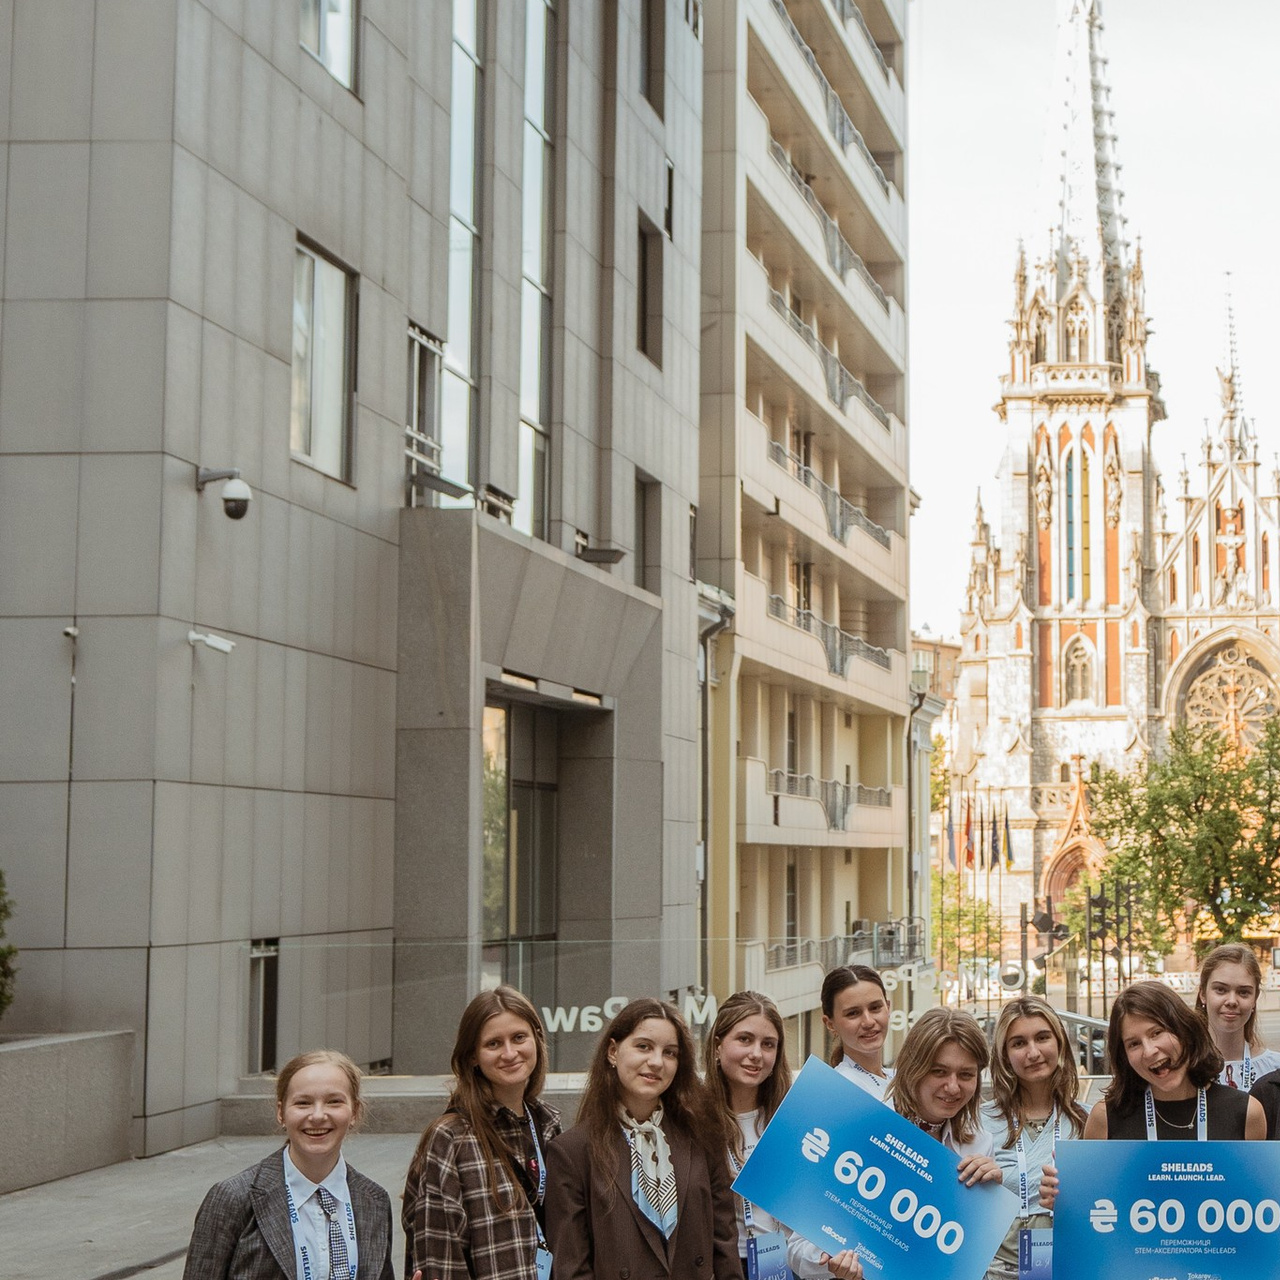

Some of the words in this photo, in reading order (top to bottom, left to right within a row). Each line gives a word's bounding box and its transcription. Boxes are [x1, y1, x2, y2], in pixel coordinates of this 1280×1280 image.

[1146, 1090, 1155, 1127] SHELEADS
[870, 1136, 890, 1154] LEARN.
[890, 1150, 917, 1171] LAUNCH.
[916, 1168, 933, 1183] LEAD.
[884, 1133, 929, 1168] SHELEADS
[1148, 1174, 1173, 1182] LEARN.
[1174, 1174, 1205, 1182] LAUNCH.
[1206, 1174, 1226, 1182] LEAD.
[1161, 1163, 1213, 1172] SHELEADS
[834, 1150, 887, 1200] 60
[889, 1188, 965, 1255] 000
[850, 1198, 893, 1231] ПЕРЕМОЖНИЦЯ
[1129, 1198, 1185, 1234] 60
[344, 1202, 356, 1241] SHELEADS
[821, 1224, 848, 1246] uBoost
[881, 1229, 910, 1252] SHELEADS
[1160, 1239, 1211, 1247] ПЕРЕМОЖНИЦЯ
[1187, 1272, 1212, 1280] Tokarev
